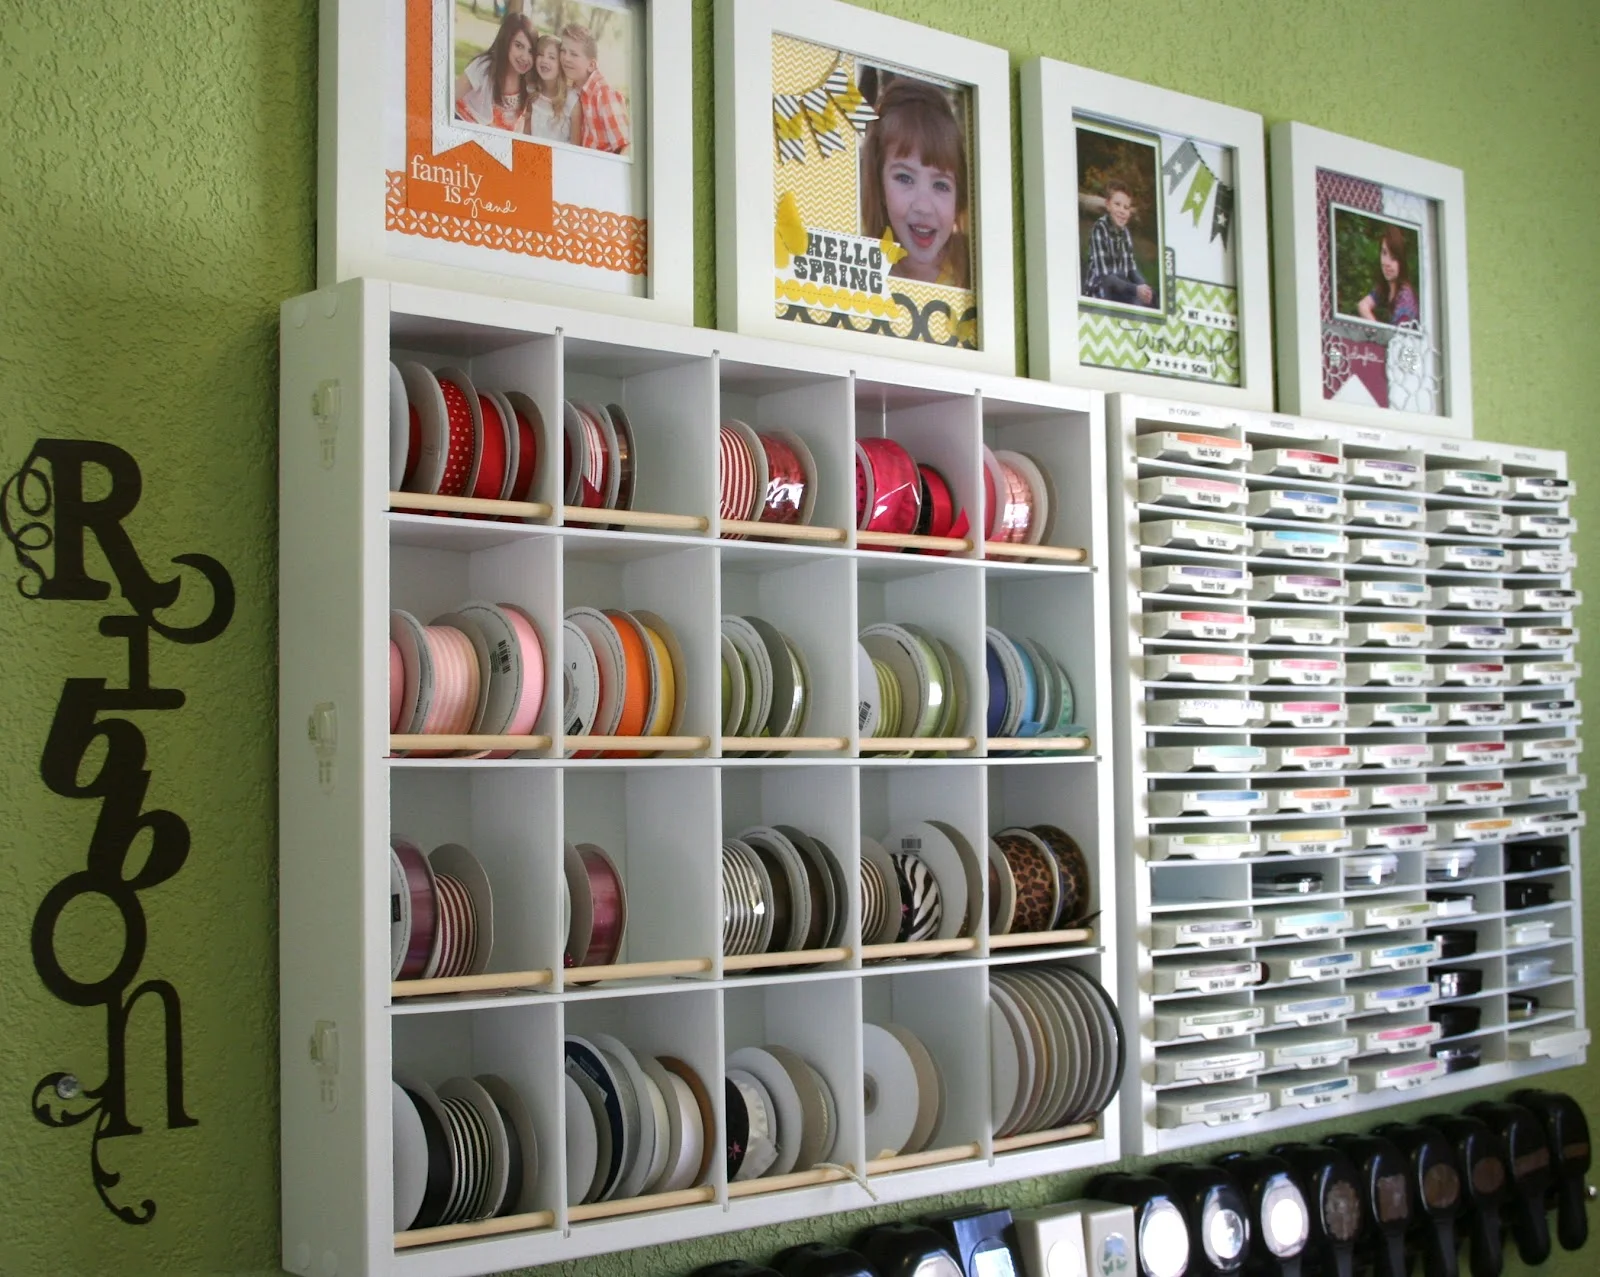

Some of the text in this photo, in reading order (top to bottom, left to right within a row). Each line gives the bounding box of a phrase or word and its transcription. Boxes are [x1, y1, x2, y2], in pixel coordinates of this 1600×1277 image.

[410, 154, 484, 196] family
[444, 177, 518, 219] is grand
[806, 232, 882, 271] HELLO
[793, 255, 883, 294] SPRING
[1191, 363, 1208, 375] SON
